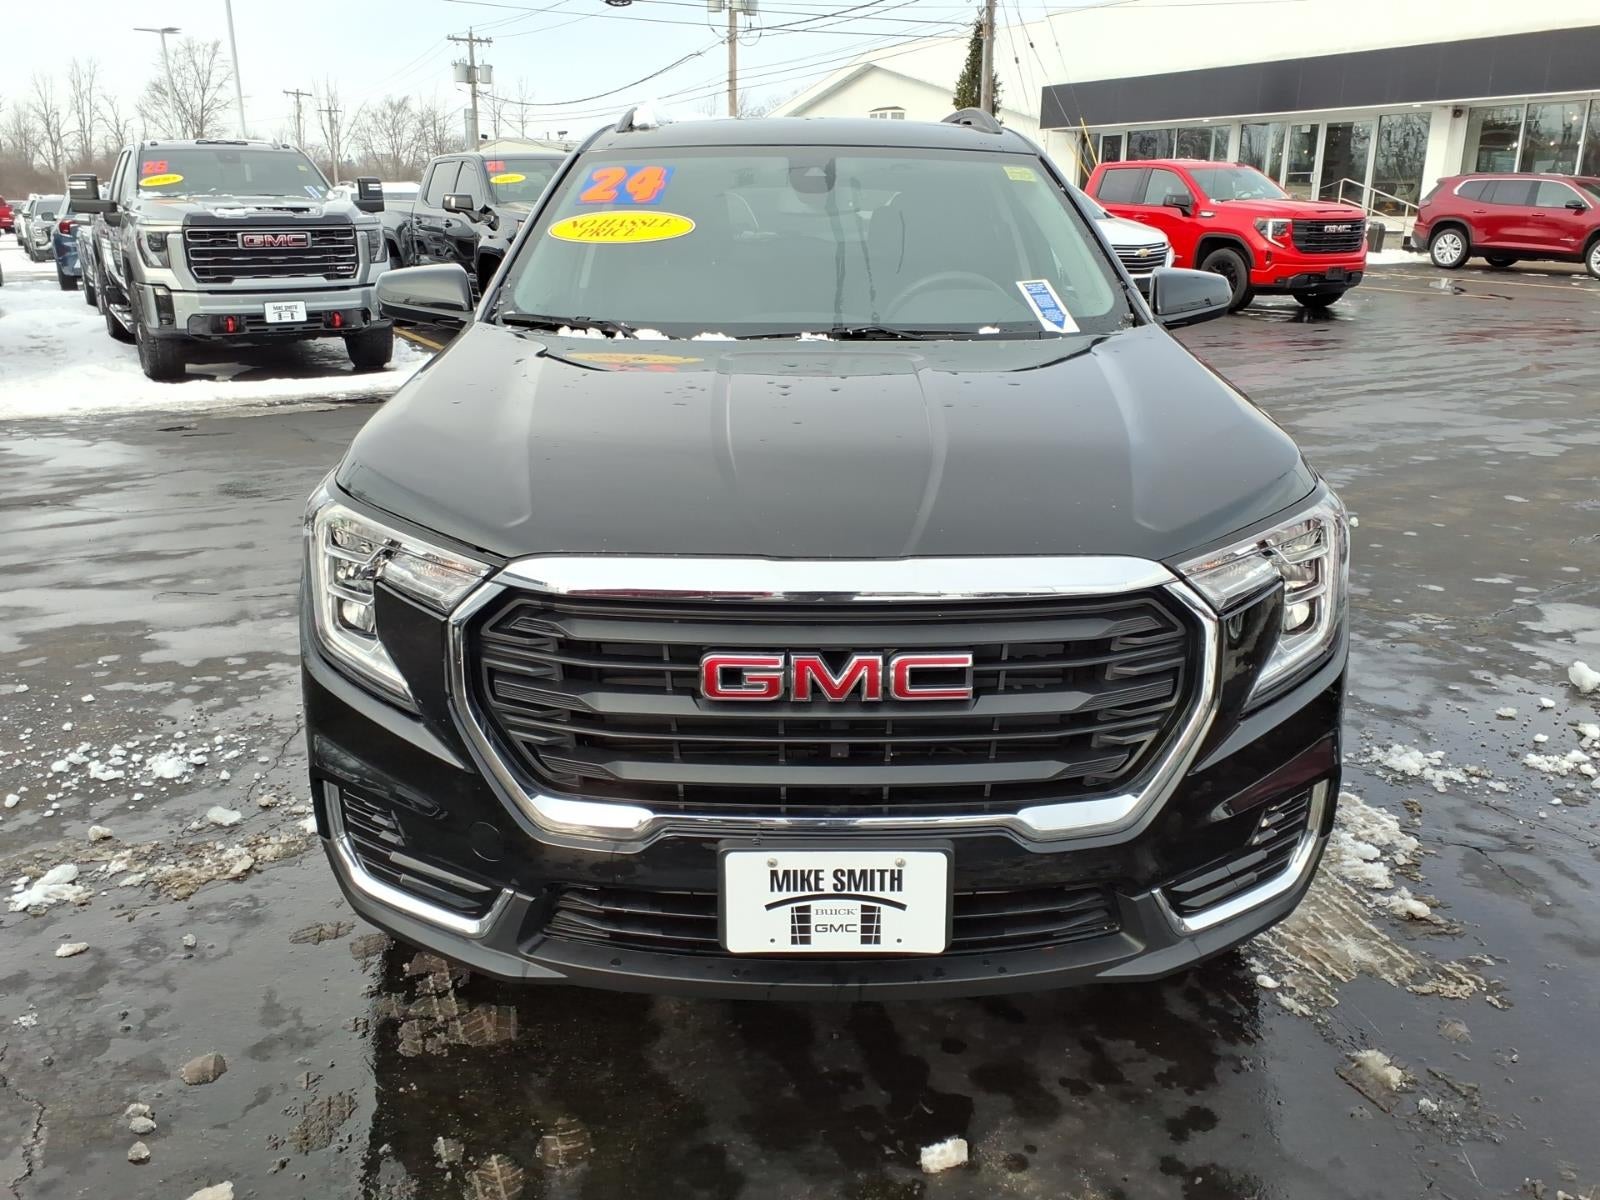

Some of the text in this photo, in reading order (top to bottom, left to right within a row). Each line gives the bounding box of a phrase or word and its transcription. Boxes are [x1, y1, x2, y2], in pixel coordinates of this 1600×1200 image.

[580, 166, 666, 204] 24
[577, 227, 637, 238] PRICE
[1324, 225, 1352, 233] GMC
[243, 234, 307, 248] GMC
[700, 652, 973, 702] GMC
[769, 868, 903, 893] MIKE SMITH
[815, 908, 858, 916] BUICK
[814, 923, 858, 934] GMC
